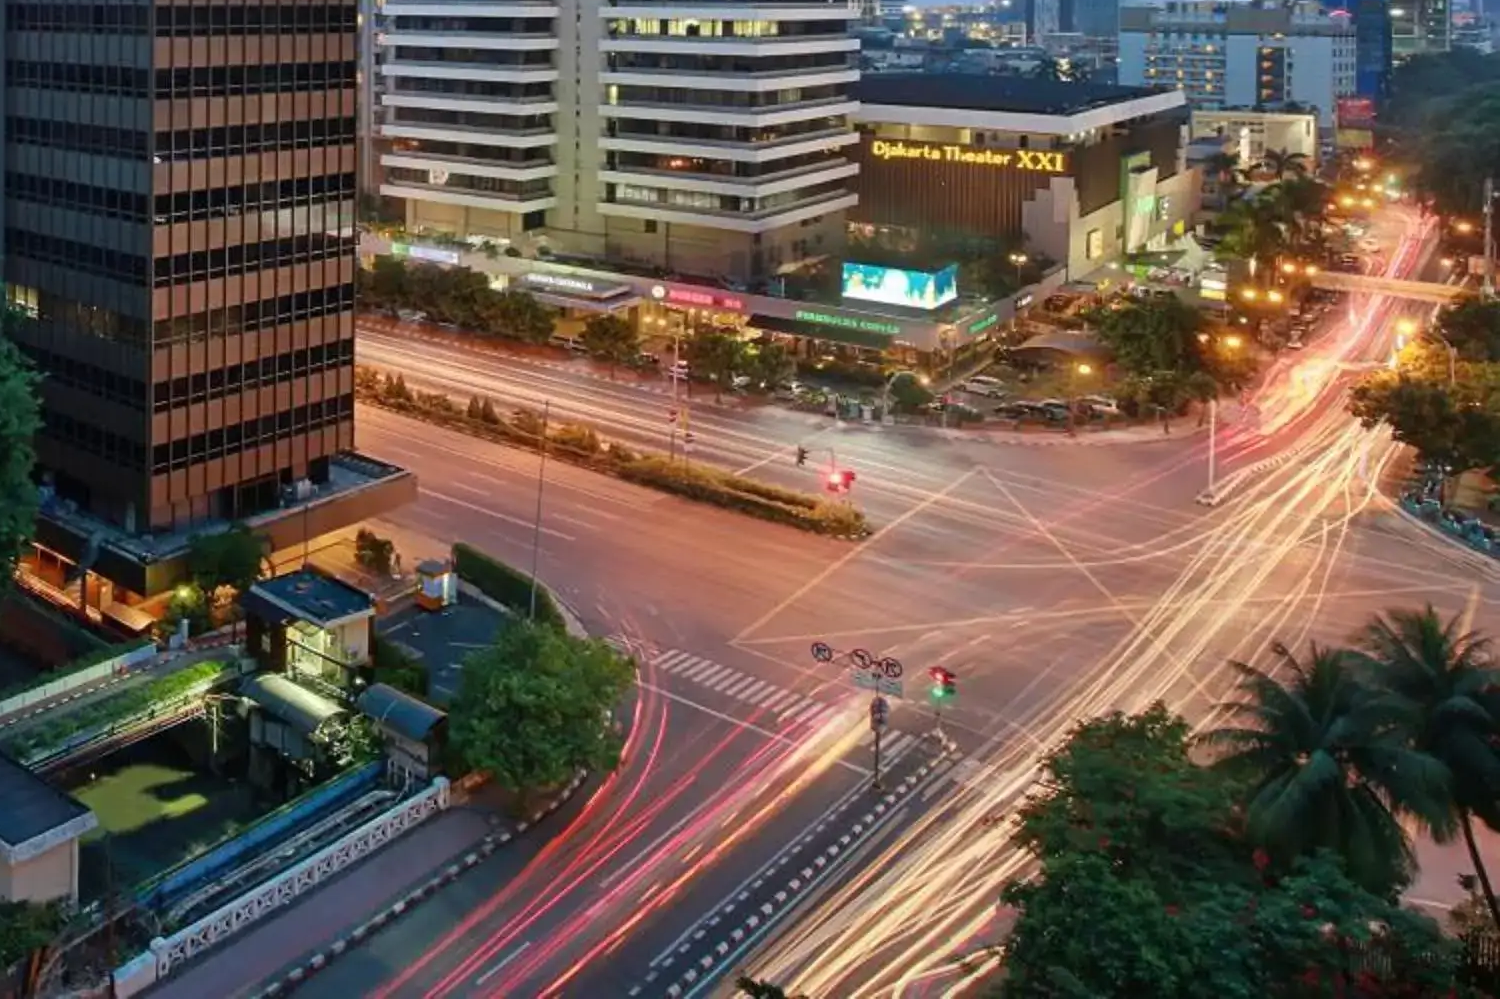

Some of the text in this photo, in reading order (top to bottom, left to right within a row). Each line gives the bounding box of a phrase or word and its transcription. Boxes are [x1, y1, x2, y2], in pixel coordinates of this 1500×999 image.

[873, 141, 1065, 172] Djakarta Theater XXI
